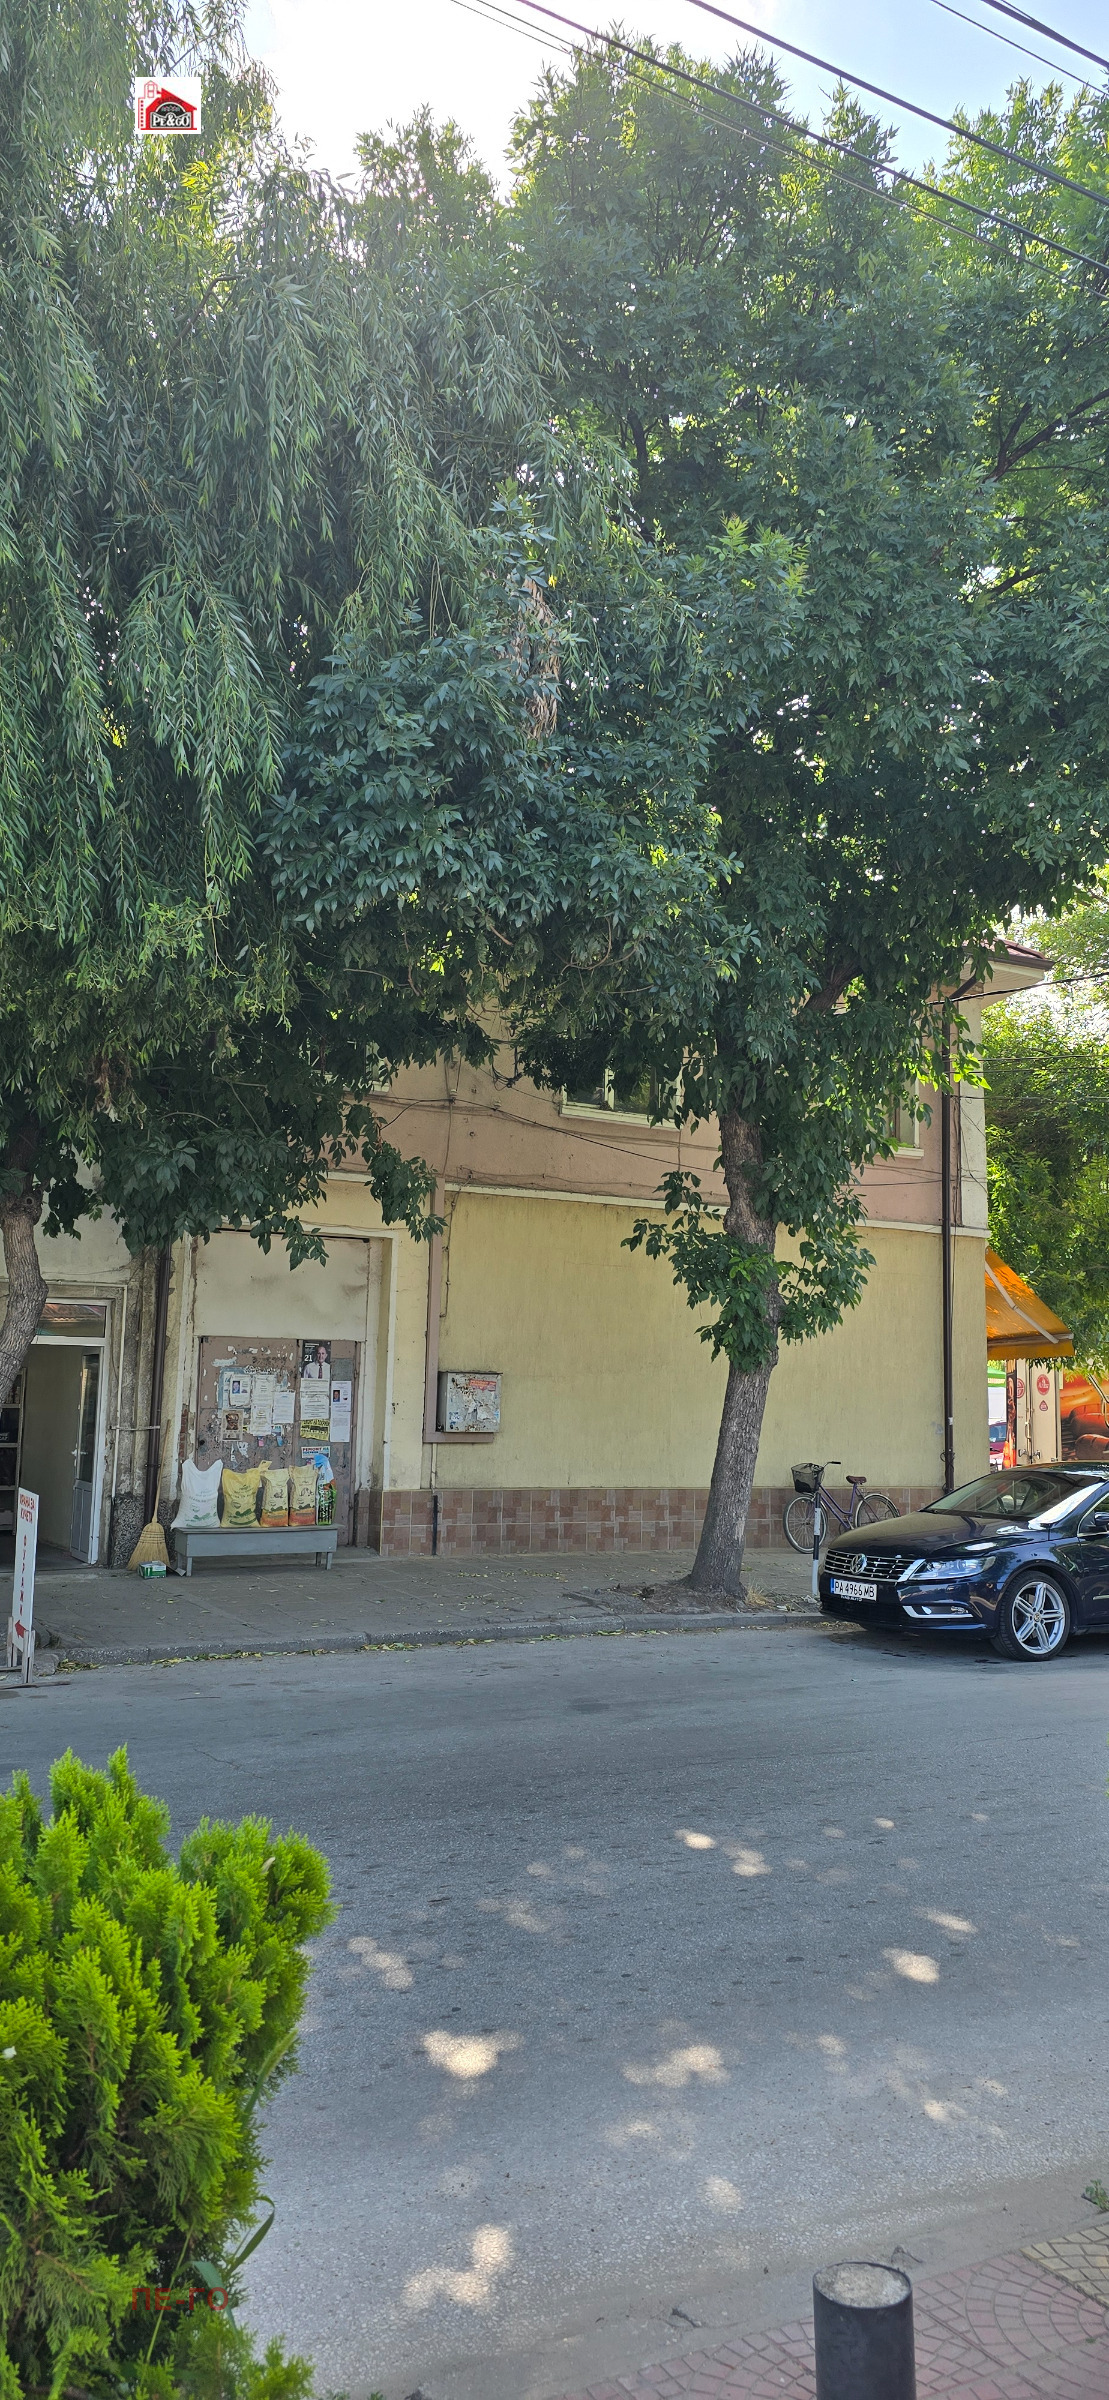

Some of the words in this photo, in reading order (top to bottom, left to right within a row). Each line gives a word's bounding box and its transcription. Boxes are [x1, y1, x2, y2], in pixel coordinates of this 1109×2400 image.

[304, 1354, 313, 1362] 21
[20, 1508, 33, 1524] КУЧЕТА
[845, 1583, 863, 1596] 4966
